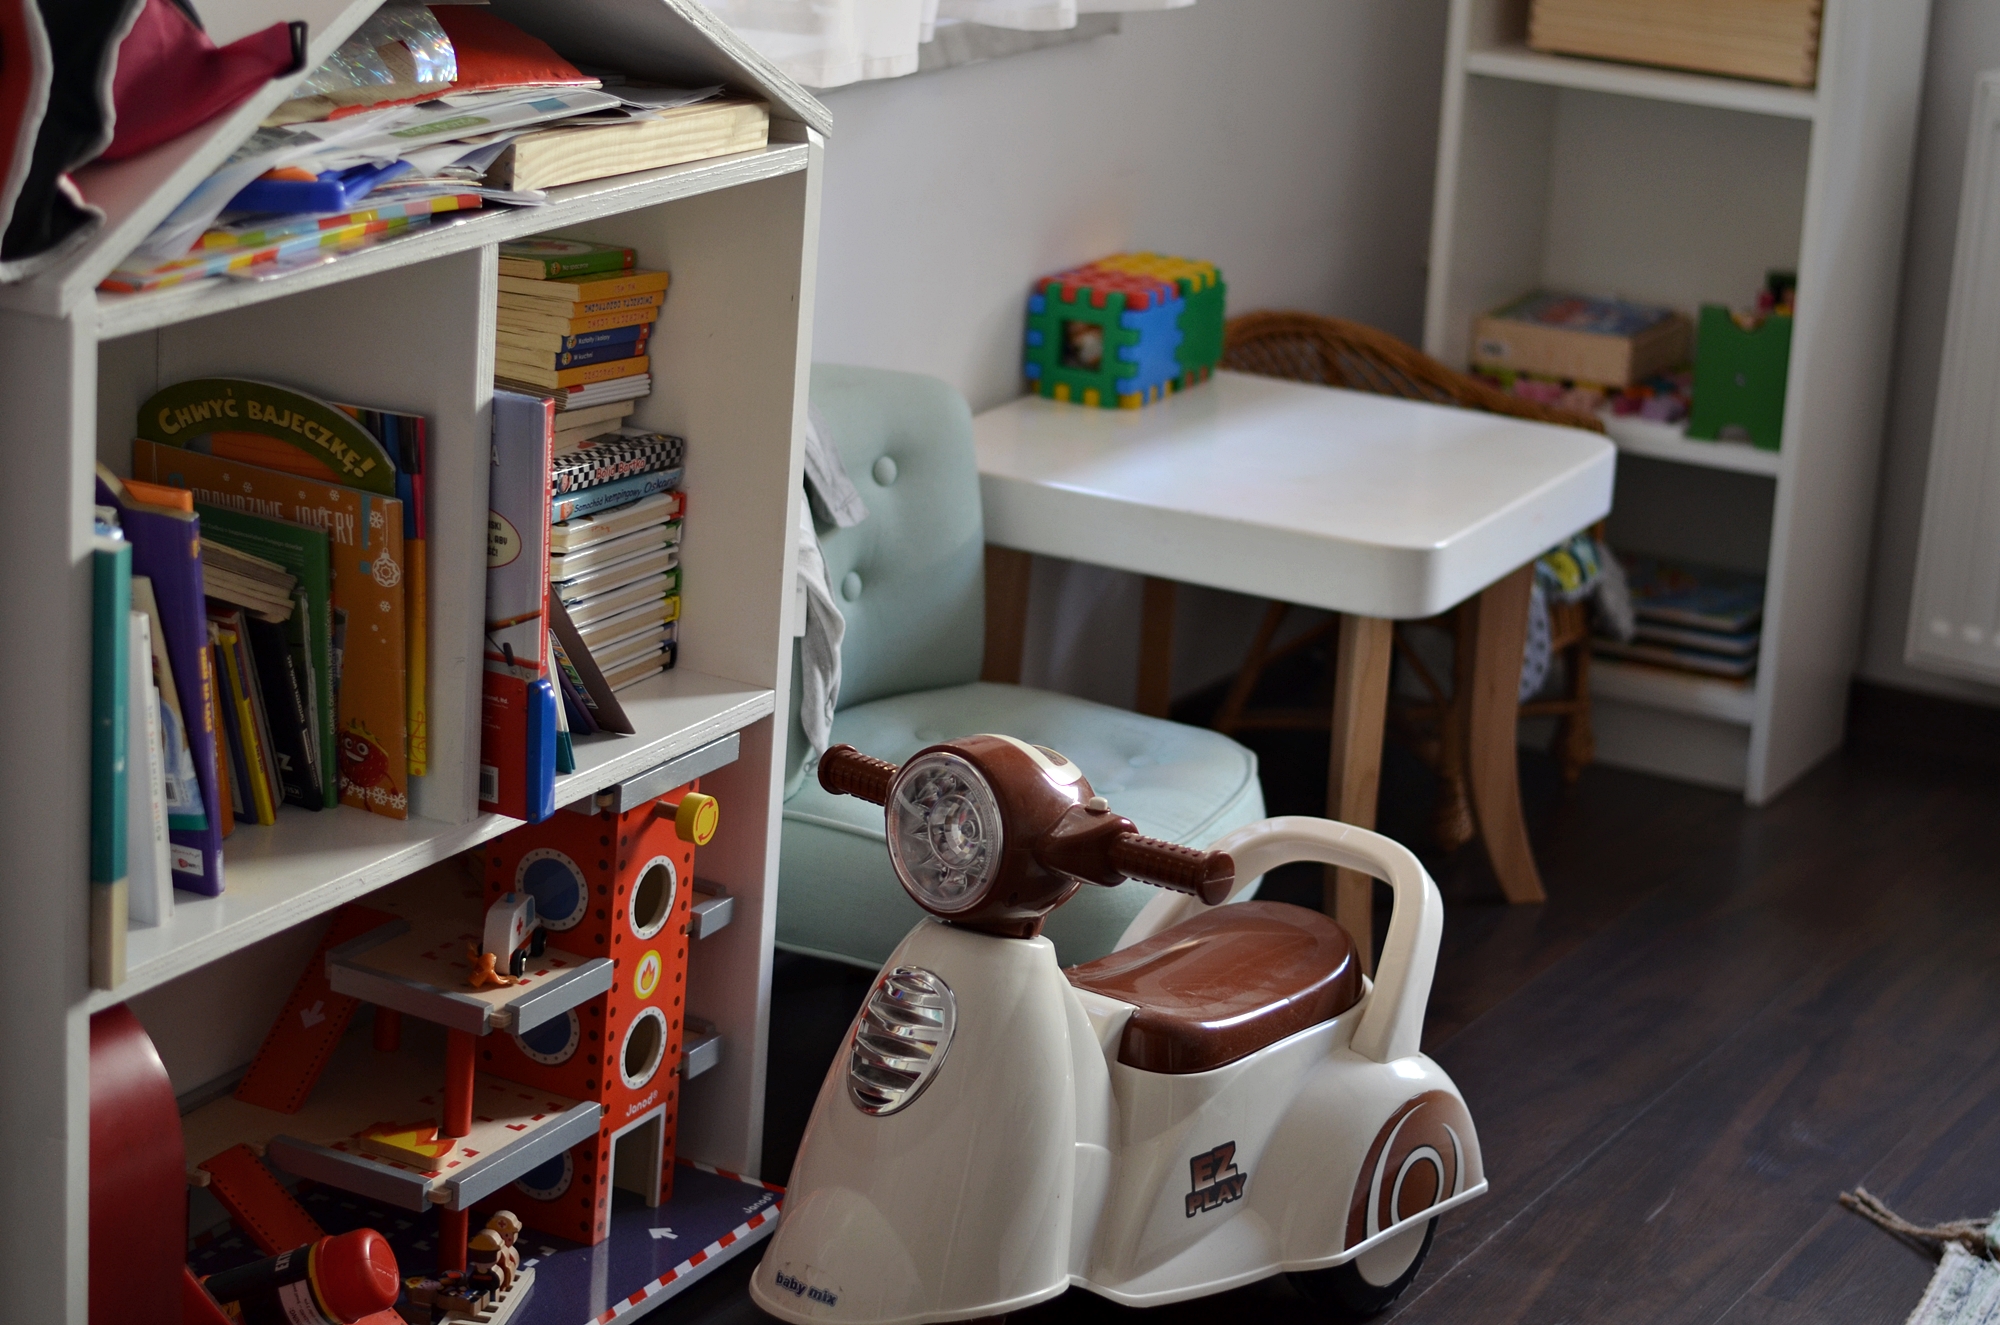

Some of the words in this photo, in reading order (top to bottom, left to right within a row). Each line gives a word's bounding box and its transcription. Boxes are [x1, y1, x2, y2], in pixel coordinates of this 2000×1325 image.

[596, 464, 616, 480] Bolid
[618, 459, 646, 474] Bartka
[643, 476, 678, 494] Oskara
[1189, 1140, 1238, 1193] EZ
[1185, 1172, 1247, 1218] PLAY
[775, 1270, 806, 1295] baby
[807, 1285, 838, 1307] mix
